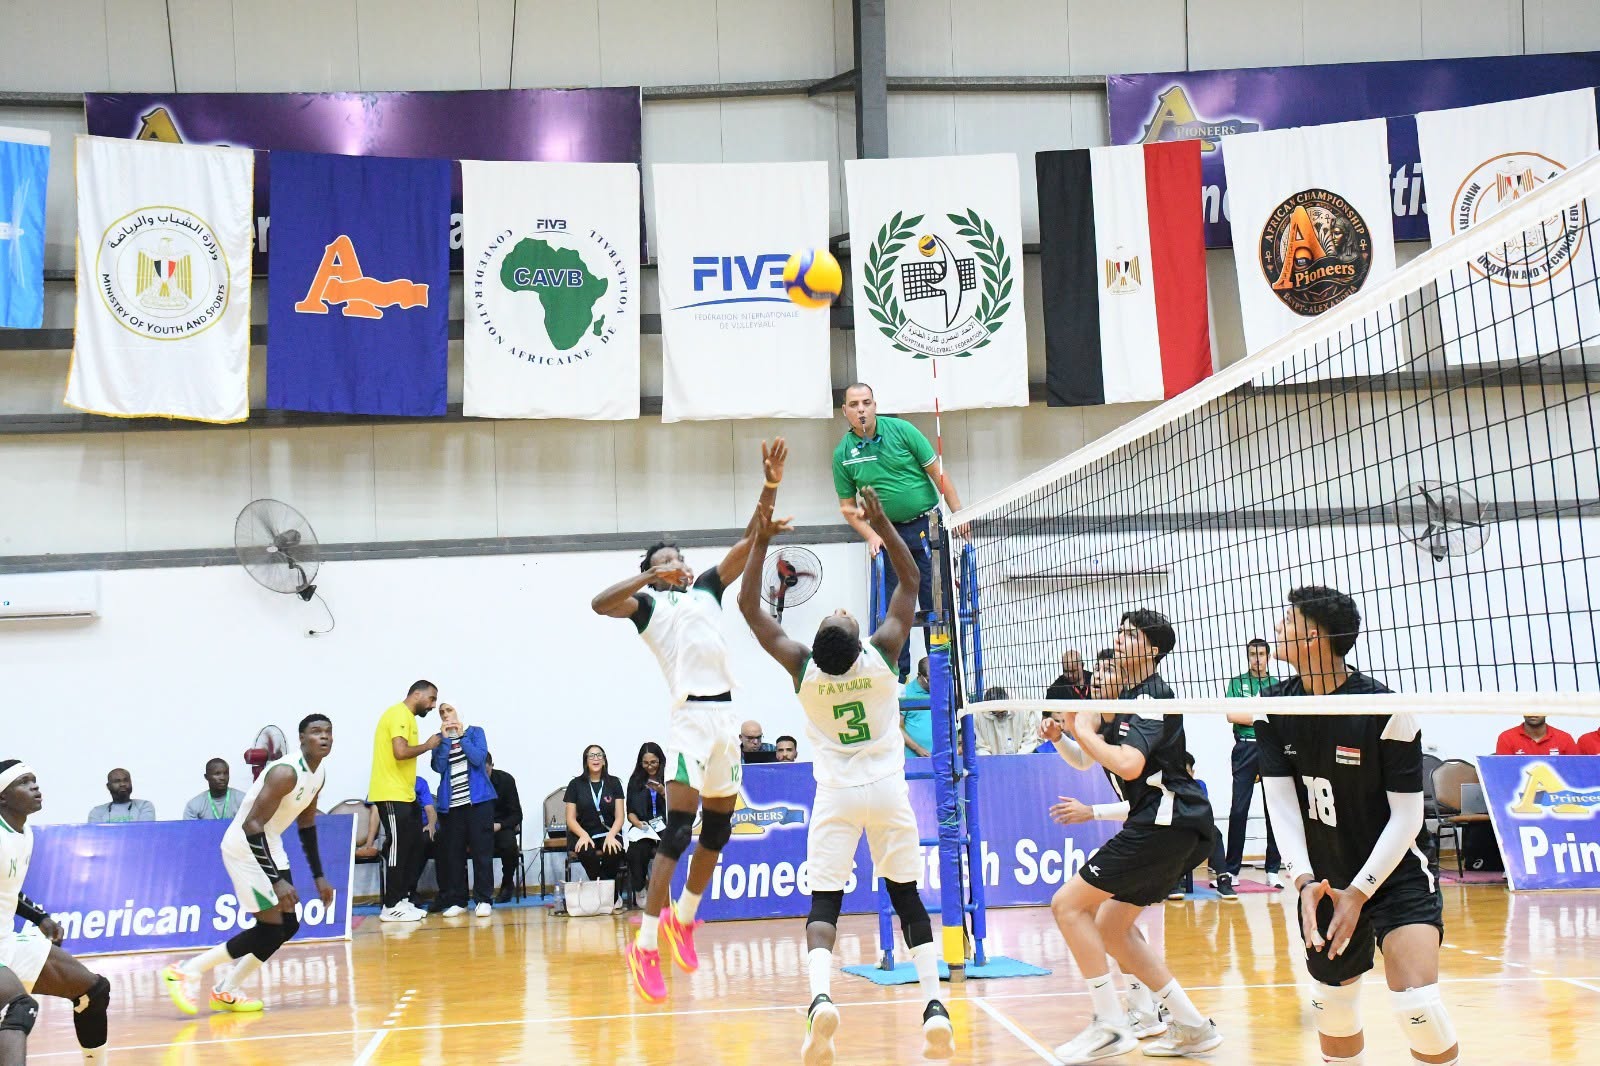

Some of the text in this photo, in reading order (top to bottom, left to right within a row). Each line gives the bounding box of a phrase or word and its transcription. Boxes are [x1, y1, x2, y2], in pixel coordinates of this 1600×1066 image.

[157, 213, 204, 235] الشباب
[536, 219, 567, 230] FIVB
[1265, 198, 1296, 243] AFRICAN
[1296, 191, 1365, 234] CHAMPIONSHIP
[108, 215, 155, 249] والرياضة
[202, 233, 218, 261] وزارة
[514, 267, 583, 287] CAVB
[590, 229, 628, 315] VOLLEYBALL
[1295, 264, 1356, 288] Pioneers
[474, 229, 514, 345] CONFEDERATION
[102, 273, 225, 335] MINISTRY OF YOUTH AND SPORTS
[741, 310, 800, 320] INTERNATIONALE
[600, 327, 617, 344] DE
[719, 320, 776, 330] DE VOLLEYBALL
[901, 330, 983, 354] EGYPTIAN VOLLEYBALL FEDERATION
[508, 347, 594, 366] AFRICAINE
[832, 700, 871, 745] 3
[1301, 775, 1337, 828] 18
